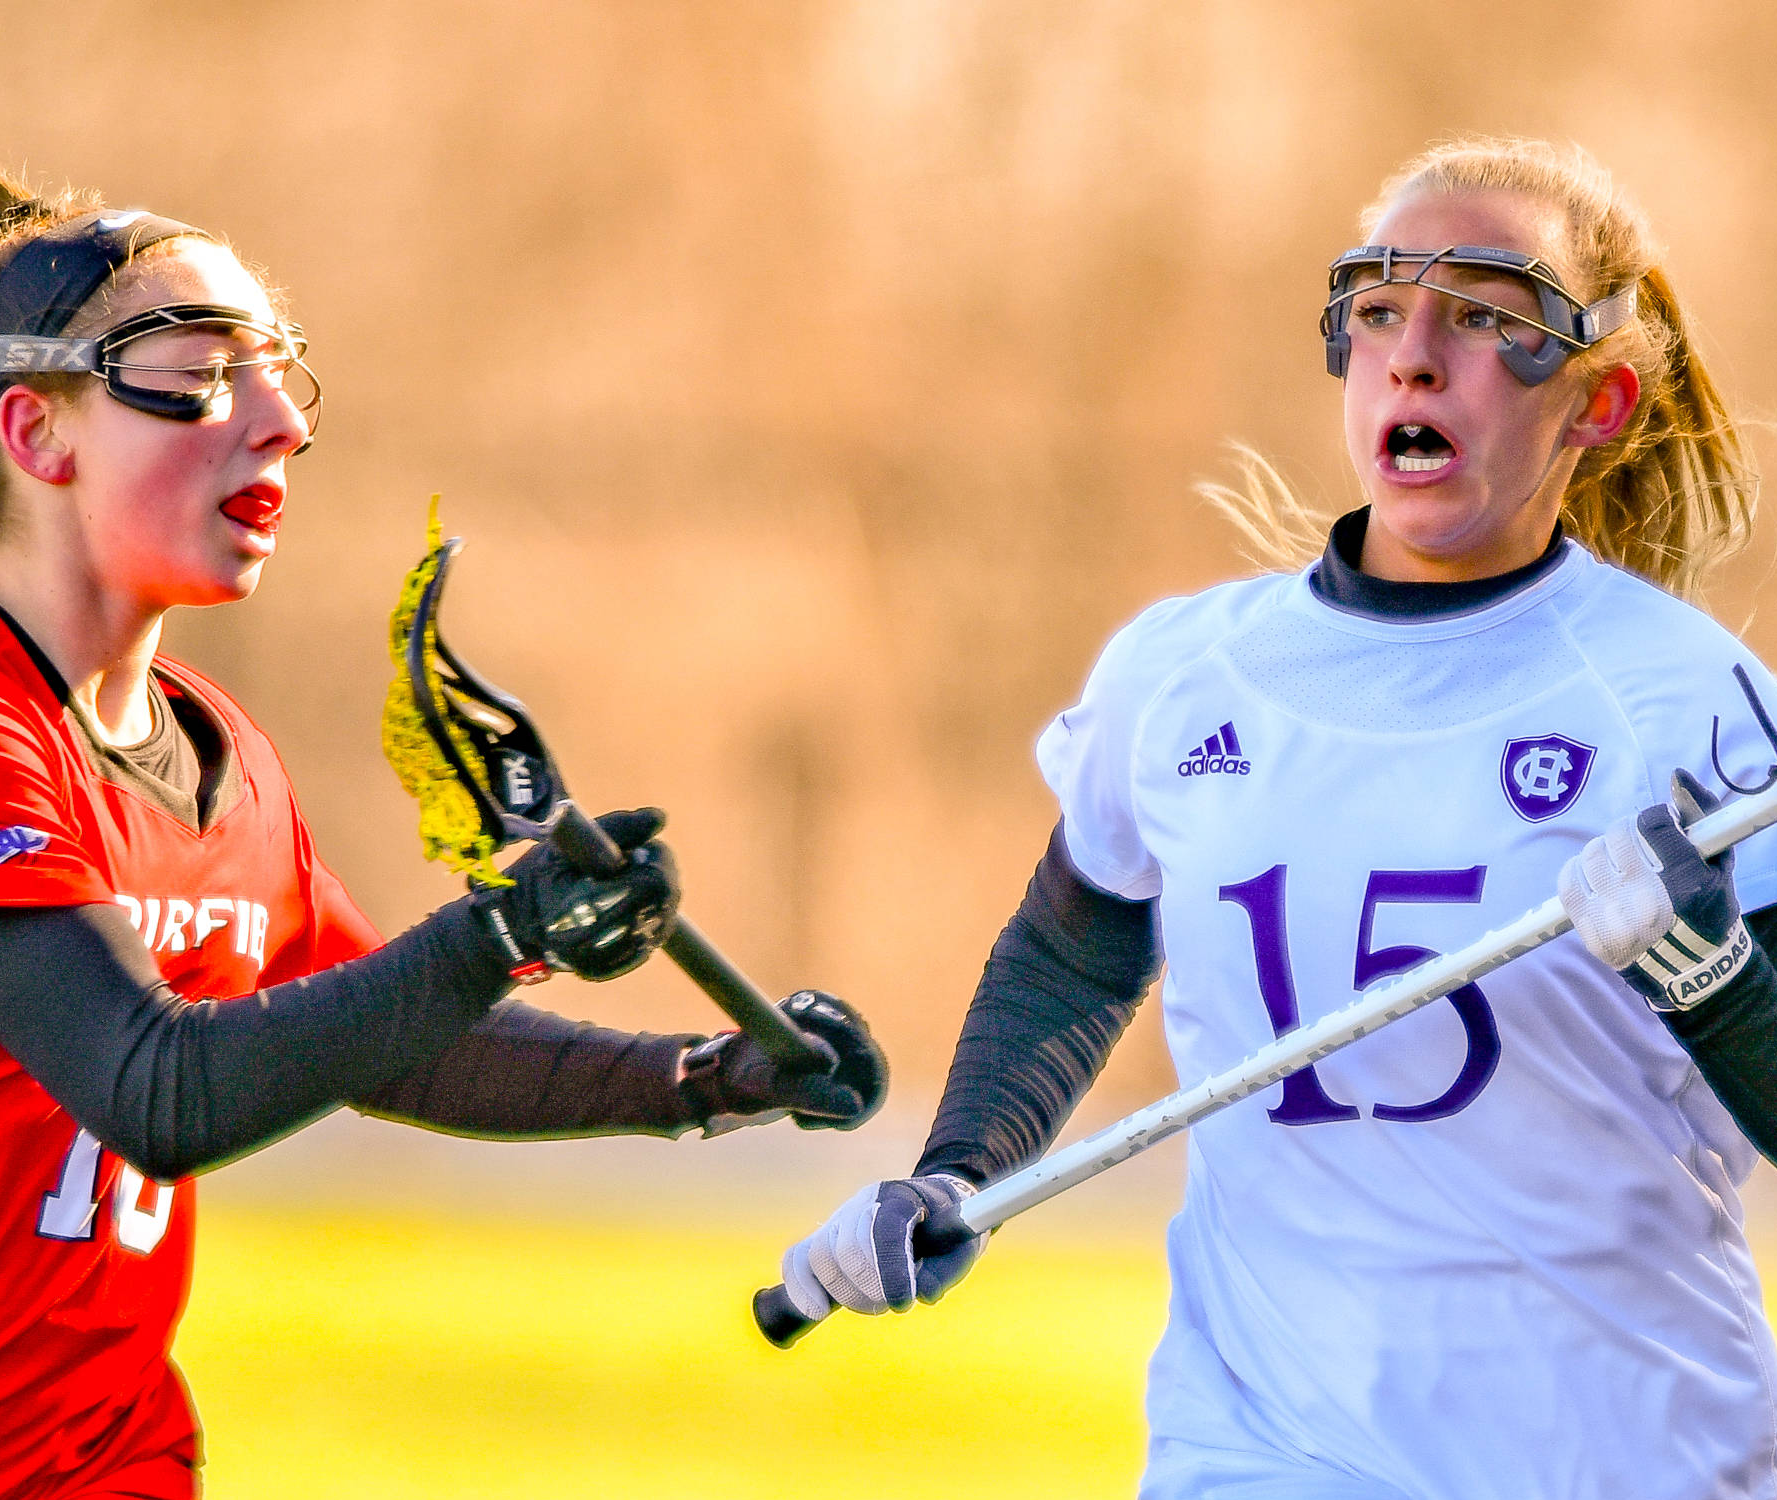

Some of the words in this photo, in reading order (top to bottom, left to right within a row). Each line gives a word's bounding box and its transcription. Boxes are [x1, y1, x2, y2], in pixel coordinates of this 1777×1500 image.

[4, 343, 89, 368] STX
[1177, 754, 1252, 777] adidas
[1680, 930, 1749, 1000] ADIDAS
[1218, 863, 1503, 1127] 15
